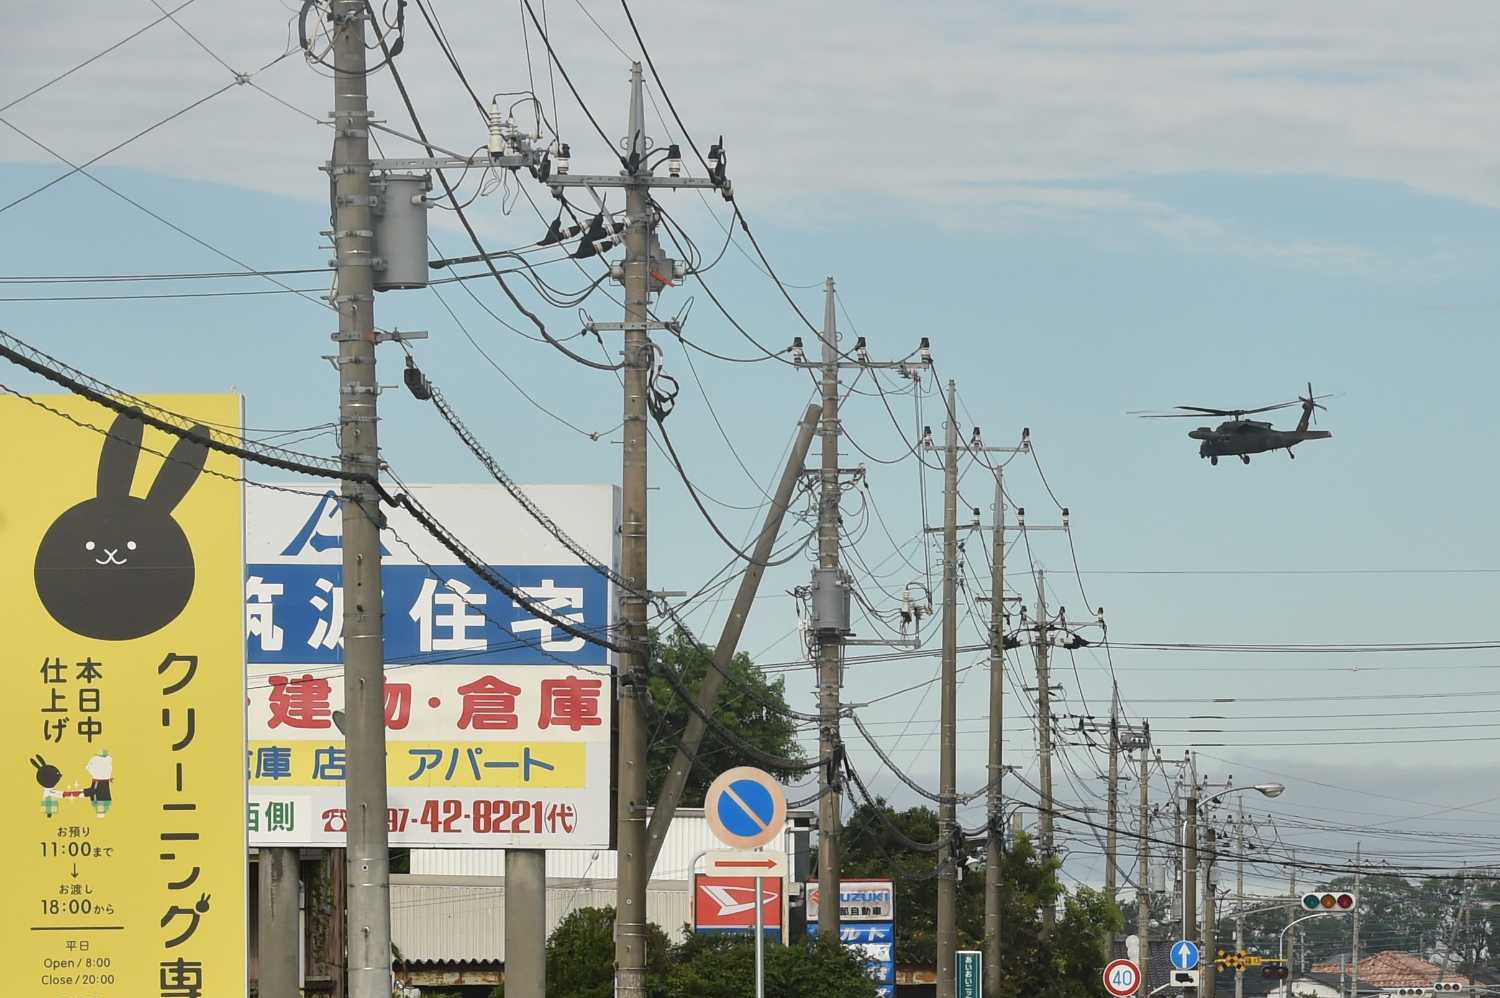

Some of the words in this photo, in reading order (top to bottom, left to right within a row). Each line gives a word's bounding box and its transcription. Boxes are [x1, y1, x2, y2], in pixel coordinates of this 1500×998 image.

[41, 657, 68, 743] 仕上げ
[76, 657, 102, 742] 本日中
[248, 746, 292, 780] 庫
[409, 747, 554, 781] アパート
[57, 826, 90, 837] お預り
[59, 884, 93, 895] お渡し
[839, 892, 890, 902] UZUKI
[65, 940, 89, 951] 平日
[1112, 969, 1133, 986] 40
